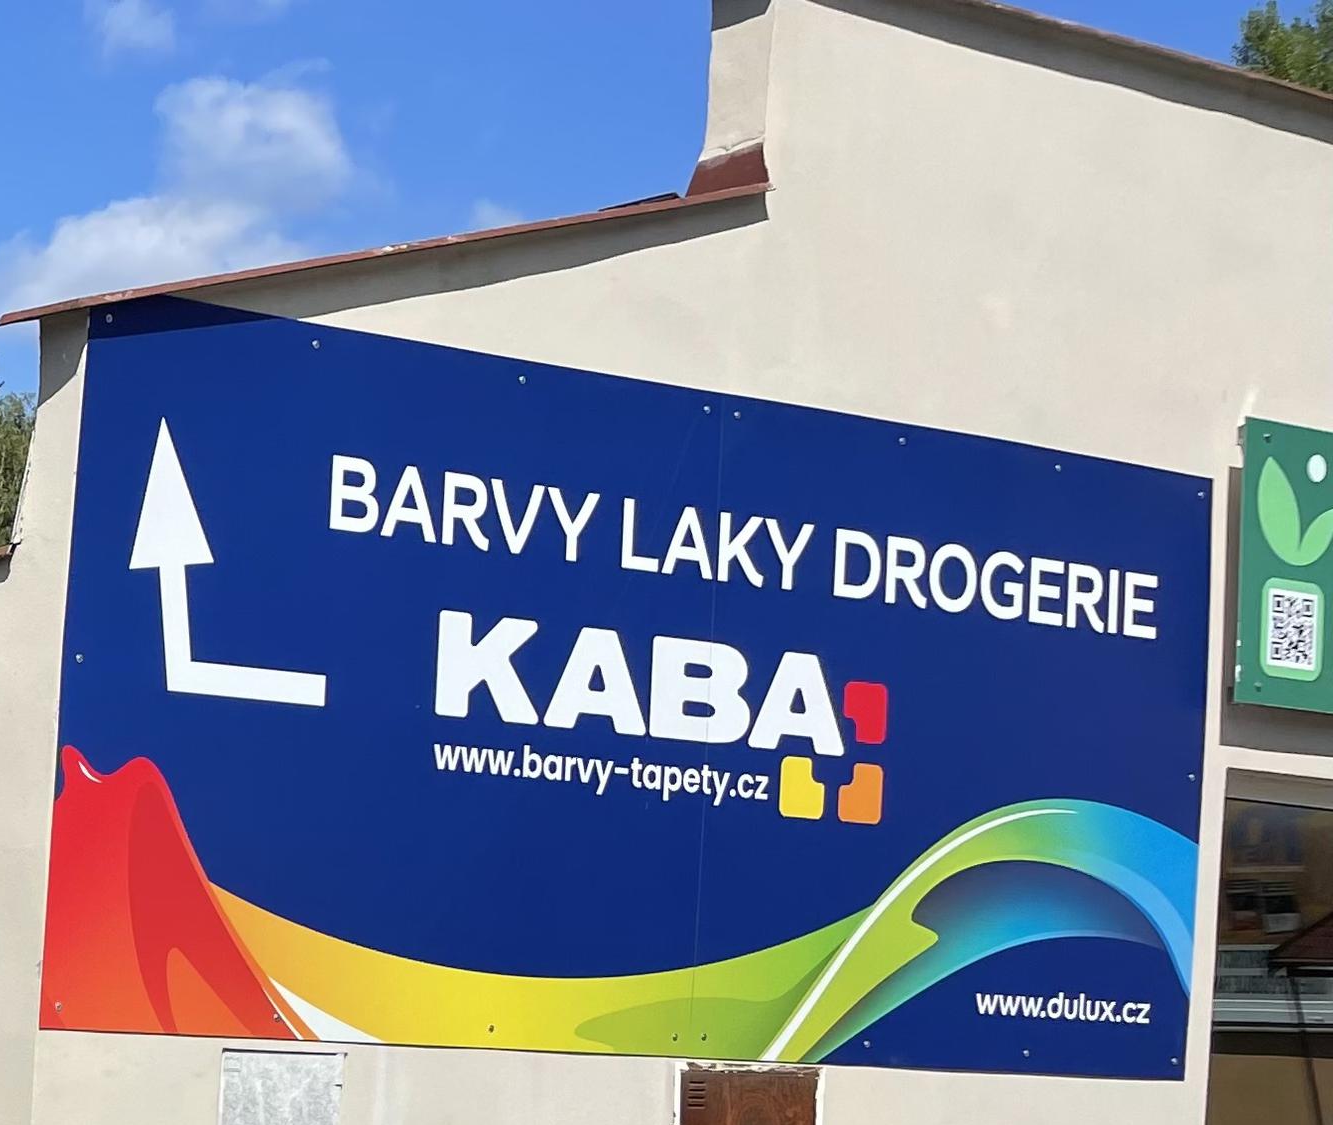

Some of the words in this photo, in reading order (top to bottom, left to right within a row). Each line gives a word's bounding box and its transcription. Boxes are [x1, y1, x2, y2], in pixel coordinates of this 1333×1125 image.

[328, 453, 600, 563] BARVY
[620, 497, 815, 591] LAKY
[832, 527, 1159, 641] DROGERIE
[434, 608, 846, 757] KABA
[433, 741, 770, 807] www.barvy-tapety.cz
[975, 991, 1151, 1024] www.dulux.cz
